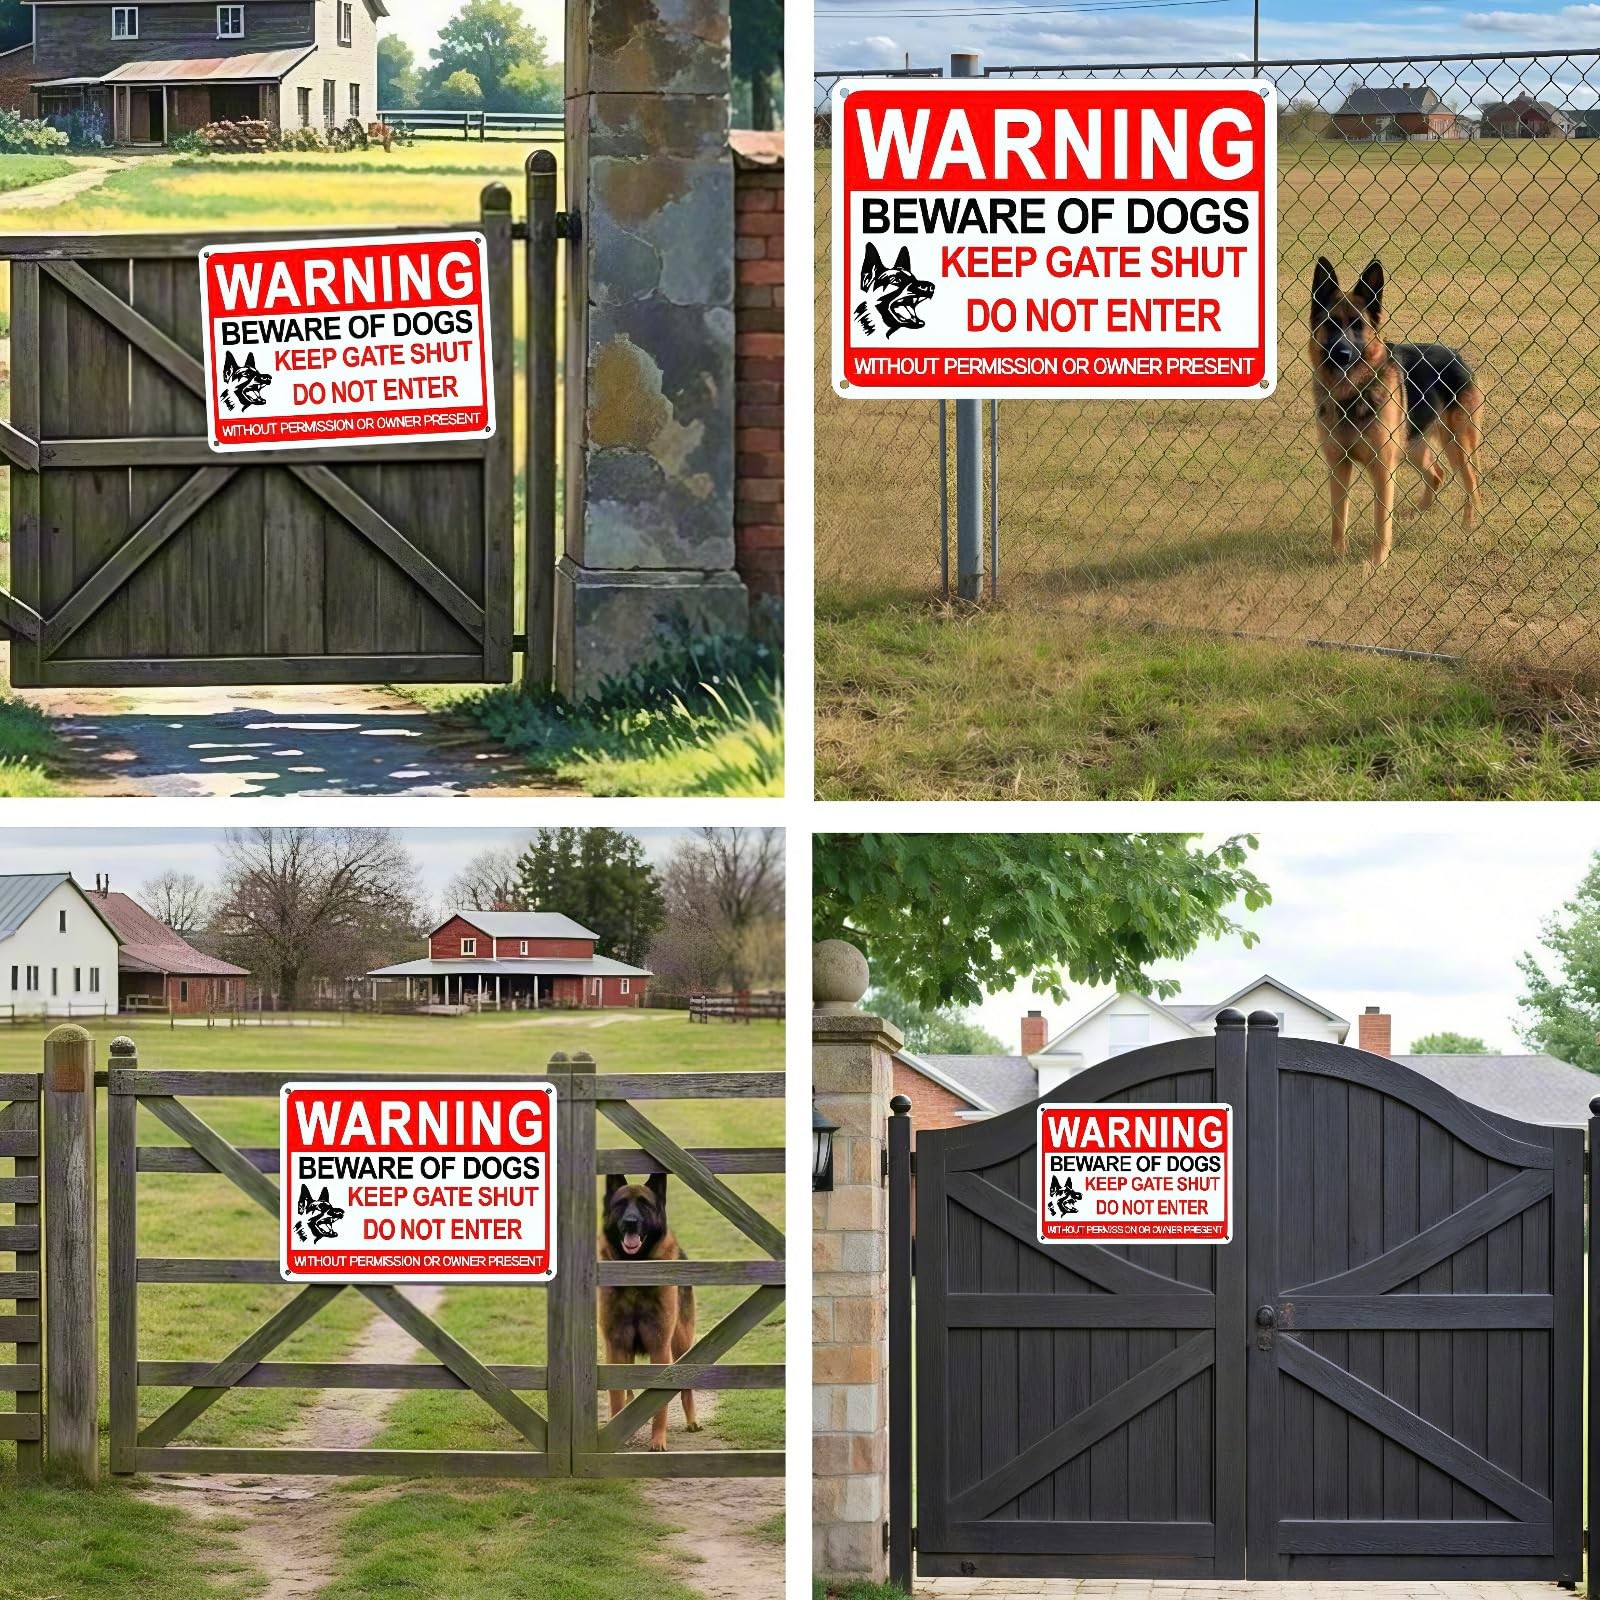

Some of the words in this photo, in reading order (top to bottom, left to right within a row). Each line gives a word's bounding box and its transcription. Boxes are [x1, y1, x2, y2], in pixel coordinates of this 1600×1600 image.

[856, 107, 1254, 180] WARNING
[862, 198, 1045, 234] BEWARE
[1057, 197, 1115, 234] OF
[1127, 197, 1249, 234] DOGS
[942, 246, 1036, 278] KEEP
[1046, 246, 1141, 278] GATE
[1151, 246, 1247, 278] SHUT
[215, 252, 474, 311] WARNING
[222, 316, 342, 346] BEWARE
[348, 314, 385, 339] OF
[393, 310, 472, 336] DOGS
[967, 298, 1018, 332] DO
[1027, 298, 1098, 332] NOT
[1107, 298, 1221, 332] ENTER
[275, 348, 336, 371] KEEP
[343, 344, 404, 366] GATE
[410, 341, 472, 364] SHUT
[854, 358, 940, 375] WITHOUT
[944, 358, 1059, 375] PERMISSION
[1062, 358, 1089, 375] OR
[1094, 358, 1162, 375] OWNER
[1167, 358, 1255, 375] PRESENT
[293, 382, 326, 406] DO
[332, 380, 378, 404] NOT
[384, 376, 458, 400] ENTER
[222, 423, 278, 437] WITHOUT
[281, 420, 354, 434] PERMISSION
[357, 418, 374, 430] OR
[377, 415, 421, 429] OWNER
[424, 412, 481, 426] PRESENT
[295, 1100, 542, 1145] WARNING
[1048, 1116, 1223, 1148] WARNING
[299, 1156, 413, 1179] BEWARE
[420, 1156, 456, 1179] OF
[464, 1156, 540, 1179] DOGS
[1050, 1156, 1131, 1172] BEWARE
[1136, 1156, 1162, 1172] OF
[1167, 1156, 1221, 1172] DOGS
[348, 1186, 408, 1207] KEEP
[413, 1186, 472, 1207] GATE
[478, 1186, 539, 1207] SHUT
[1085, 1177, 1127, 1191] KEEP
[1132, 1177, 1173, 1191] GATE
[1177, 1177, 1220, 1191] SHUT
[1096, 1200, 1119, 1215] DO
[1123, 1200, 1154, 1215] NOT
[1158, 1200, 1208, 1215] ENTER
[364, 1219, 395, 1240] DO
[401, 1219, 445, 1240] NOT
[451, 1219, 522, 1240] ENTER
[1087, 1226, 1137, 1234] PERMISSON
[294, 1256, 347, 1266] WITHOUT
[350, 1256, 421, 1266] PERMISSION
[424, 1256, 440, 1266] OR
[443, 1256, 486, 1266] OWNER
[489, 1256, 543, 1266] PRESENT
